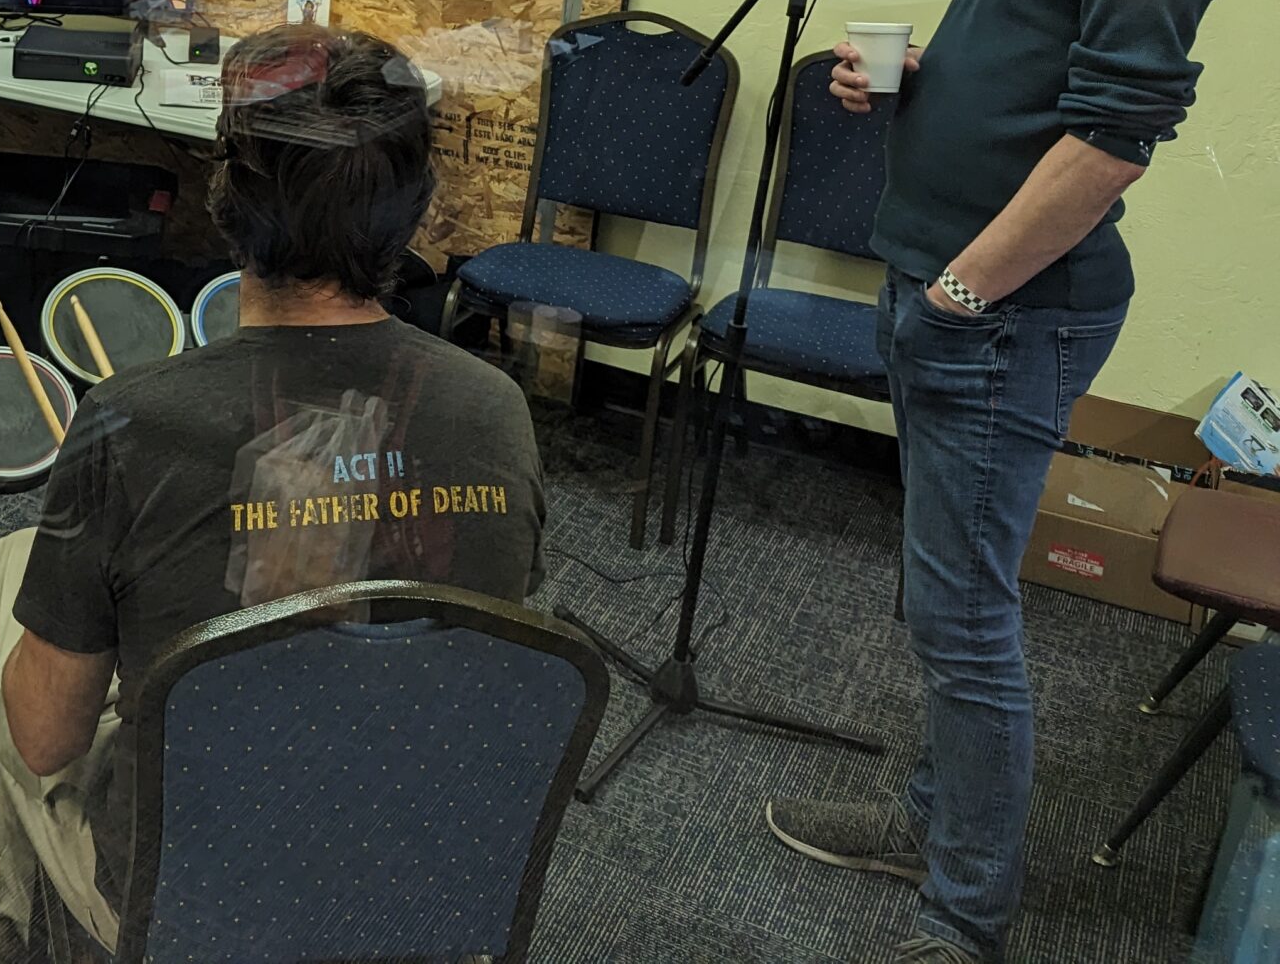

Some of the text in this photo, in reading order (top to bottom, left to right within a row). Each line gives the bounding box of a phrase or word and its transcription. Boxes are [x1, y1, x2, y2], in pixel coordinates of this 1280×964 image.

[333, 453, 377, 483] ACT
[231, 485, 507, 531] THE FATHER OF DEATH
[1056, 555, 1095, 572] FRAGILE
